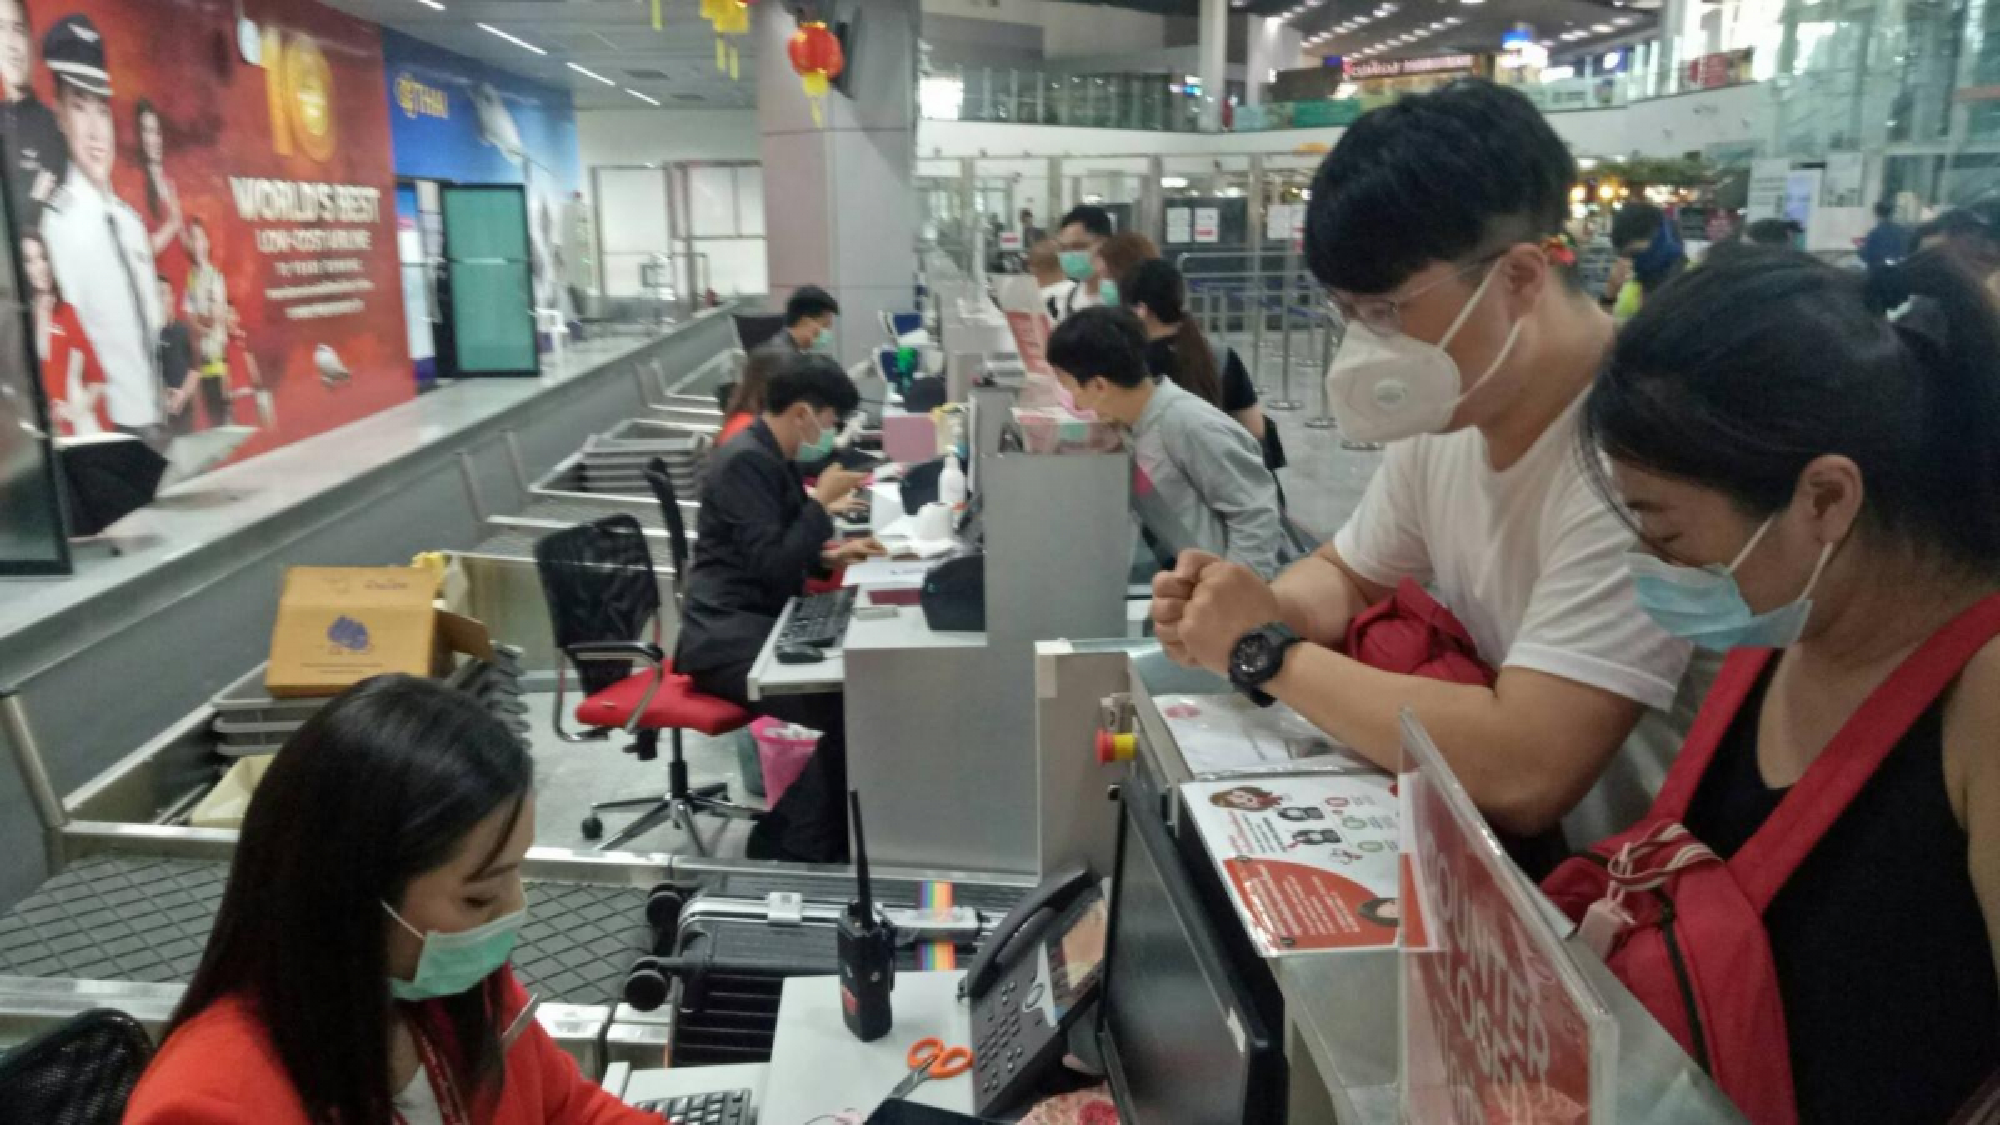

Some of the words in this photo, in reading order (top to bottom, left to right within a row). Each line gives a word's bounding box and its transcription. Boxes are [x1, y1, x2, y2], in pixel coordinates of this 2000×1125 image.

[412, 81, 448, 119] THAI
[228, 175, 334, 222] WORLD'S
[335, 184, 381, 223] BEST
